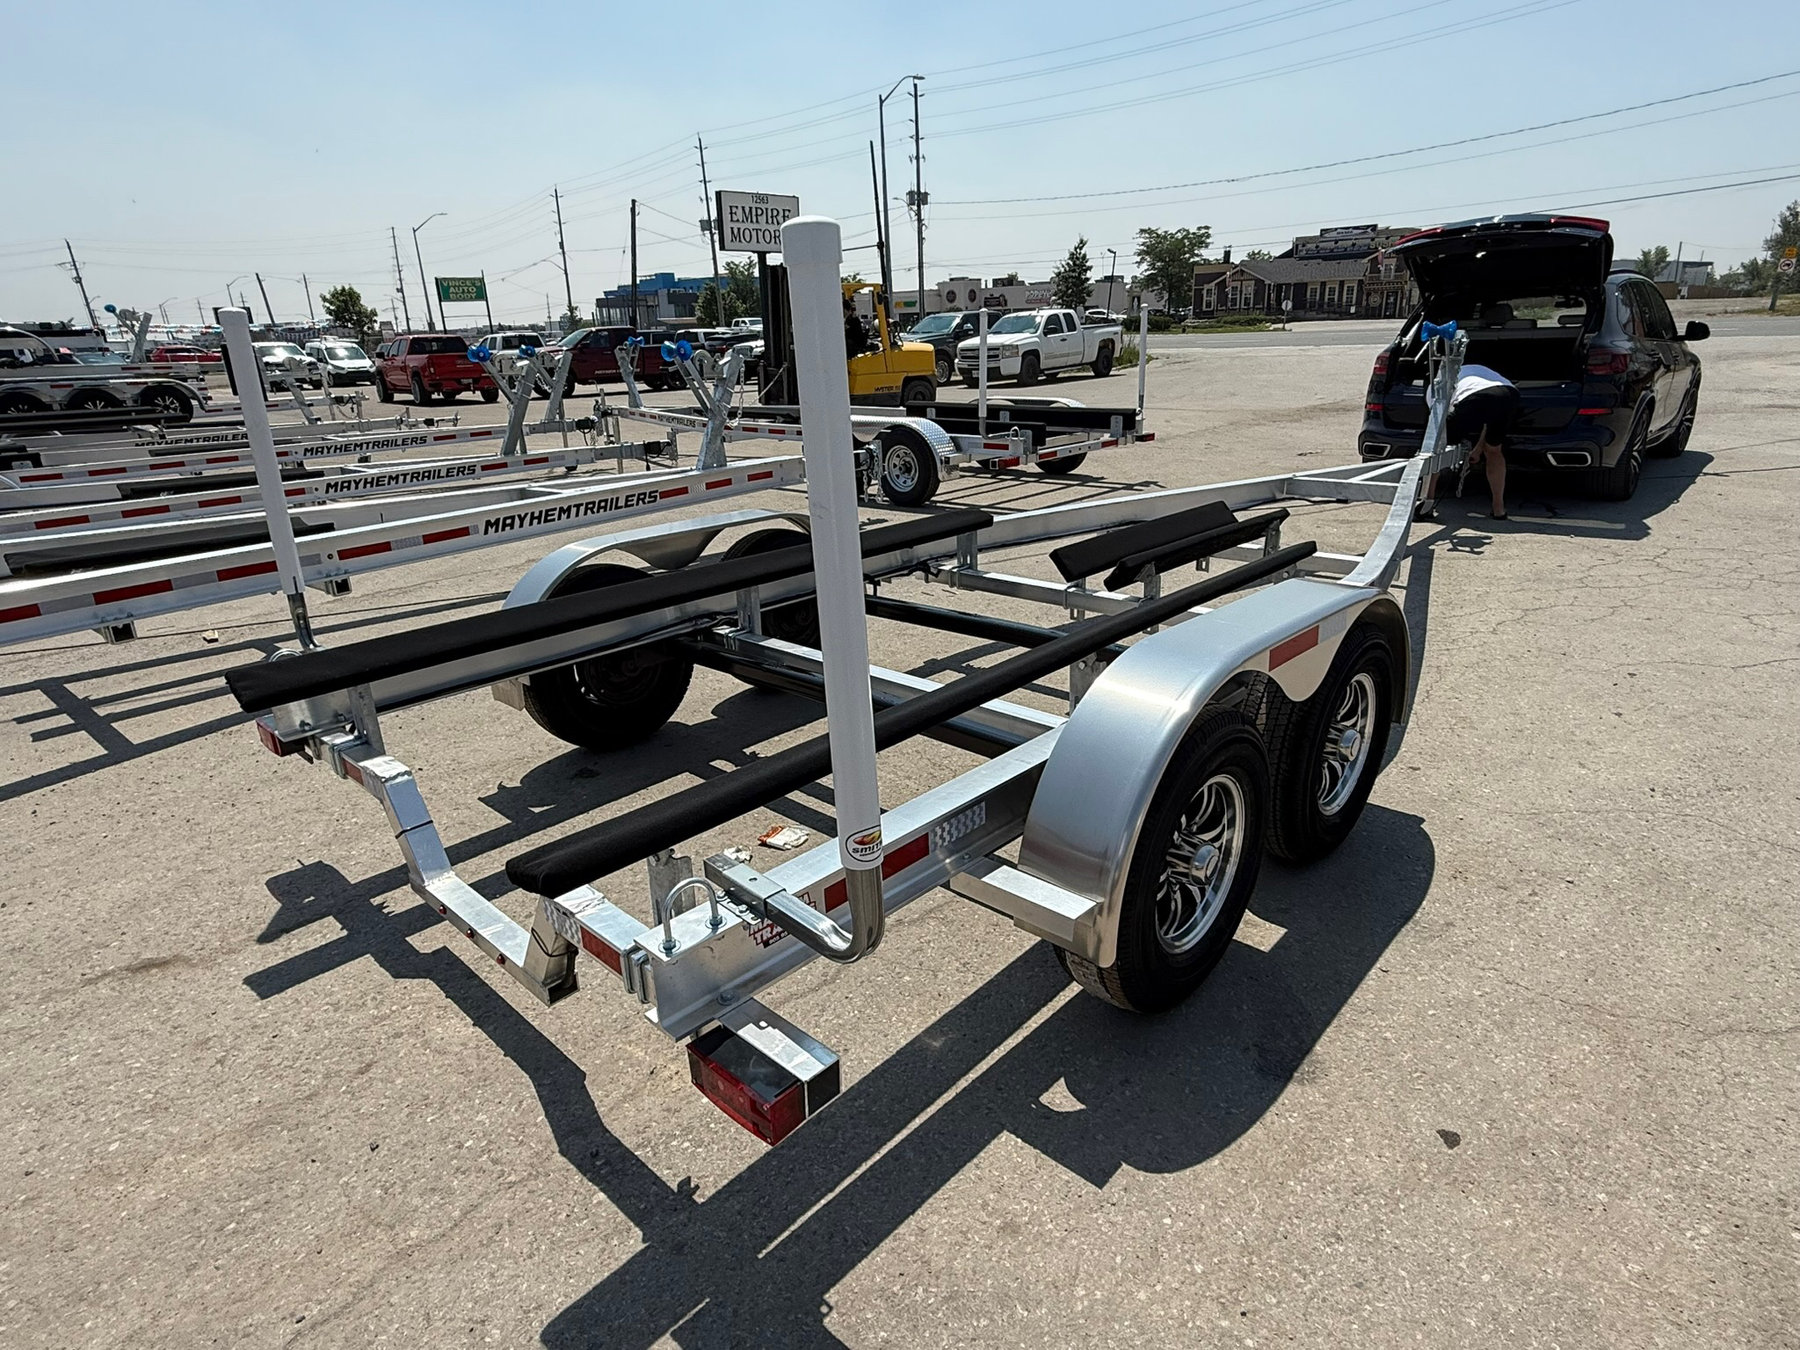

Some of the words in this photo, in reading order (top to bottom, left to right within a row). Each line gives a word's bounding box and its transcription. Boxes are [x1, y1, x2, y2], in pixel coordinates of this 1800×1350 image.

[728, 205, 792, 226] EMPIRE
[729, 226, 782, 246] MOTOR
[441, 279, 481, 287] VINCE'S
[303, 435, 428, 457] MAYHEMTRAILERS
[324, 464, 477, 494] MAYHEMTRAILERS
[483, 489, 659, 536] MAYHEMTRAILERS
[851, 842, 881, 854] SMIT
